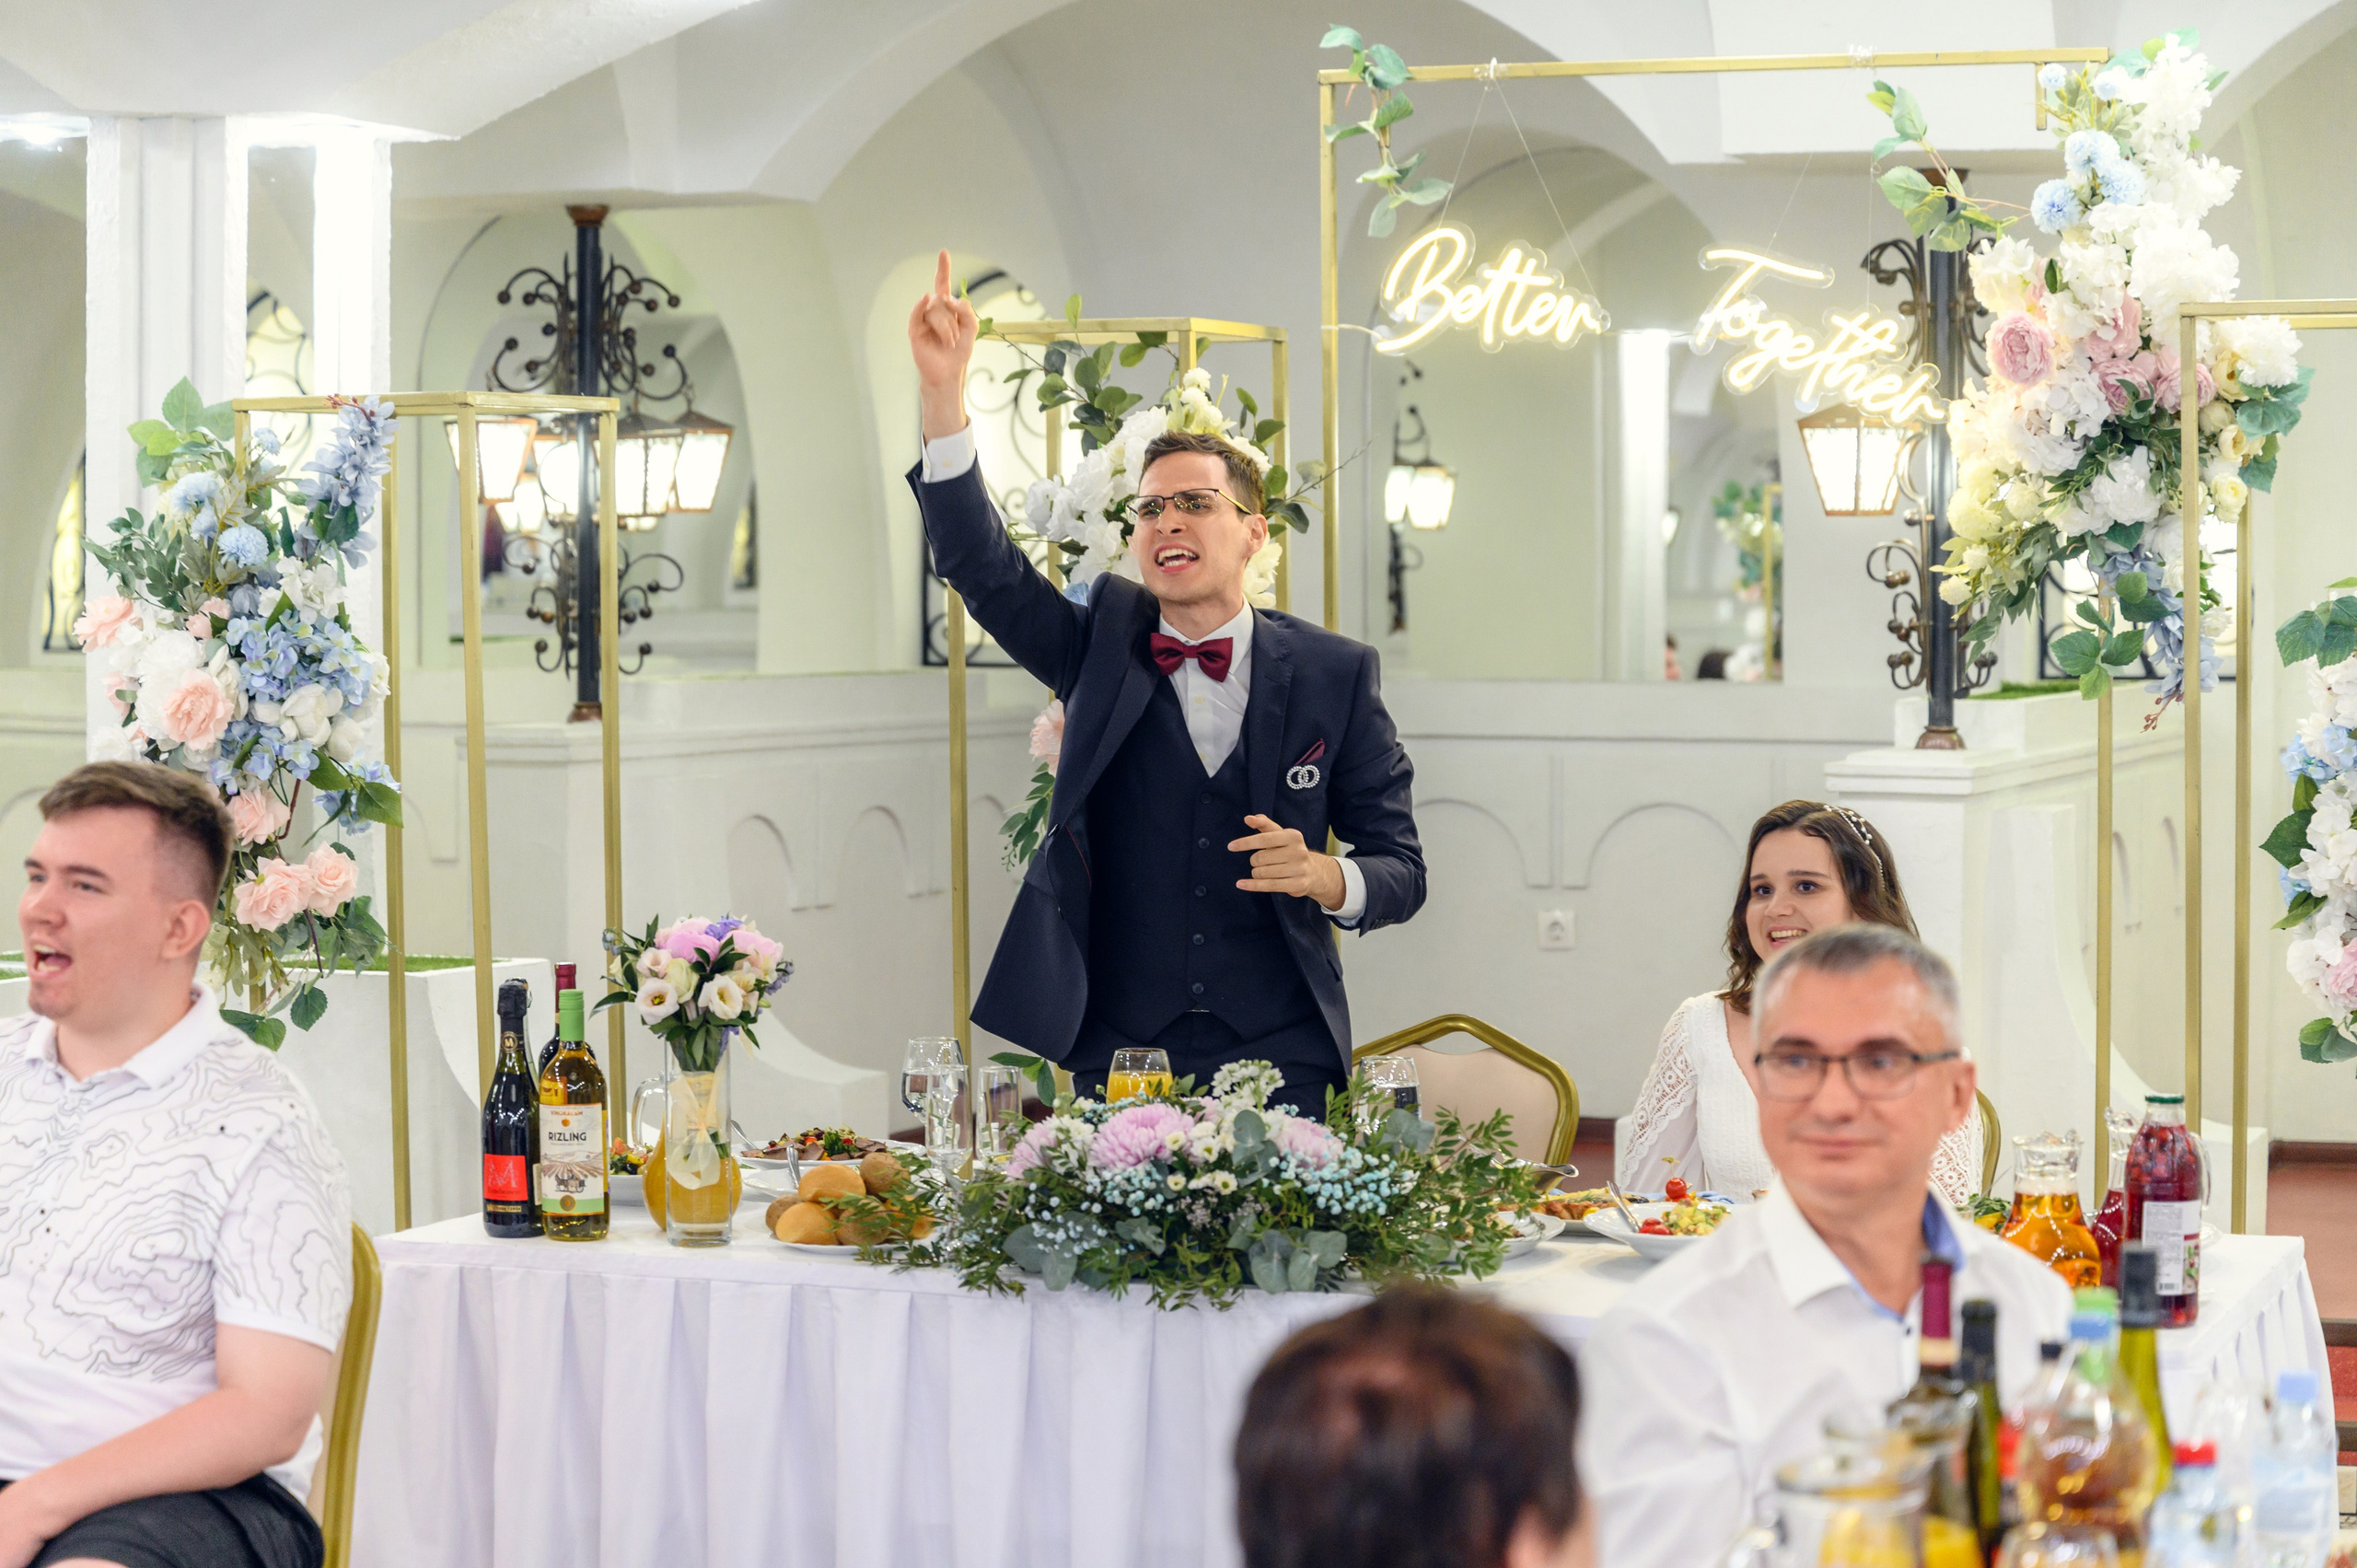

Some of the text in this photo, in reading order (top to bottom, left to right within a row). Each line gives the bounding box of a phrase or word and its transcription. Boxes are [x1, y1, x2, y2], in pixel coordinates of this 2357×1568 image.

[1376, 226, 1945, 423] Better Together
[548, 1132, 587, 1143] RIZLING
[487, 1157, 518, 1189] M
